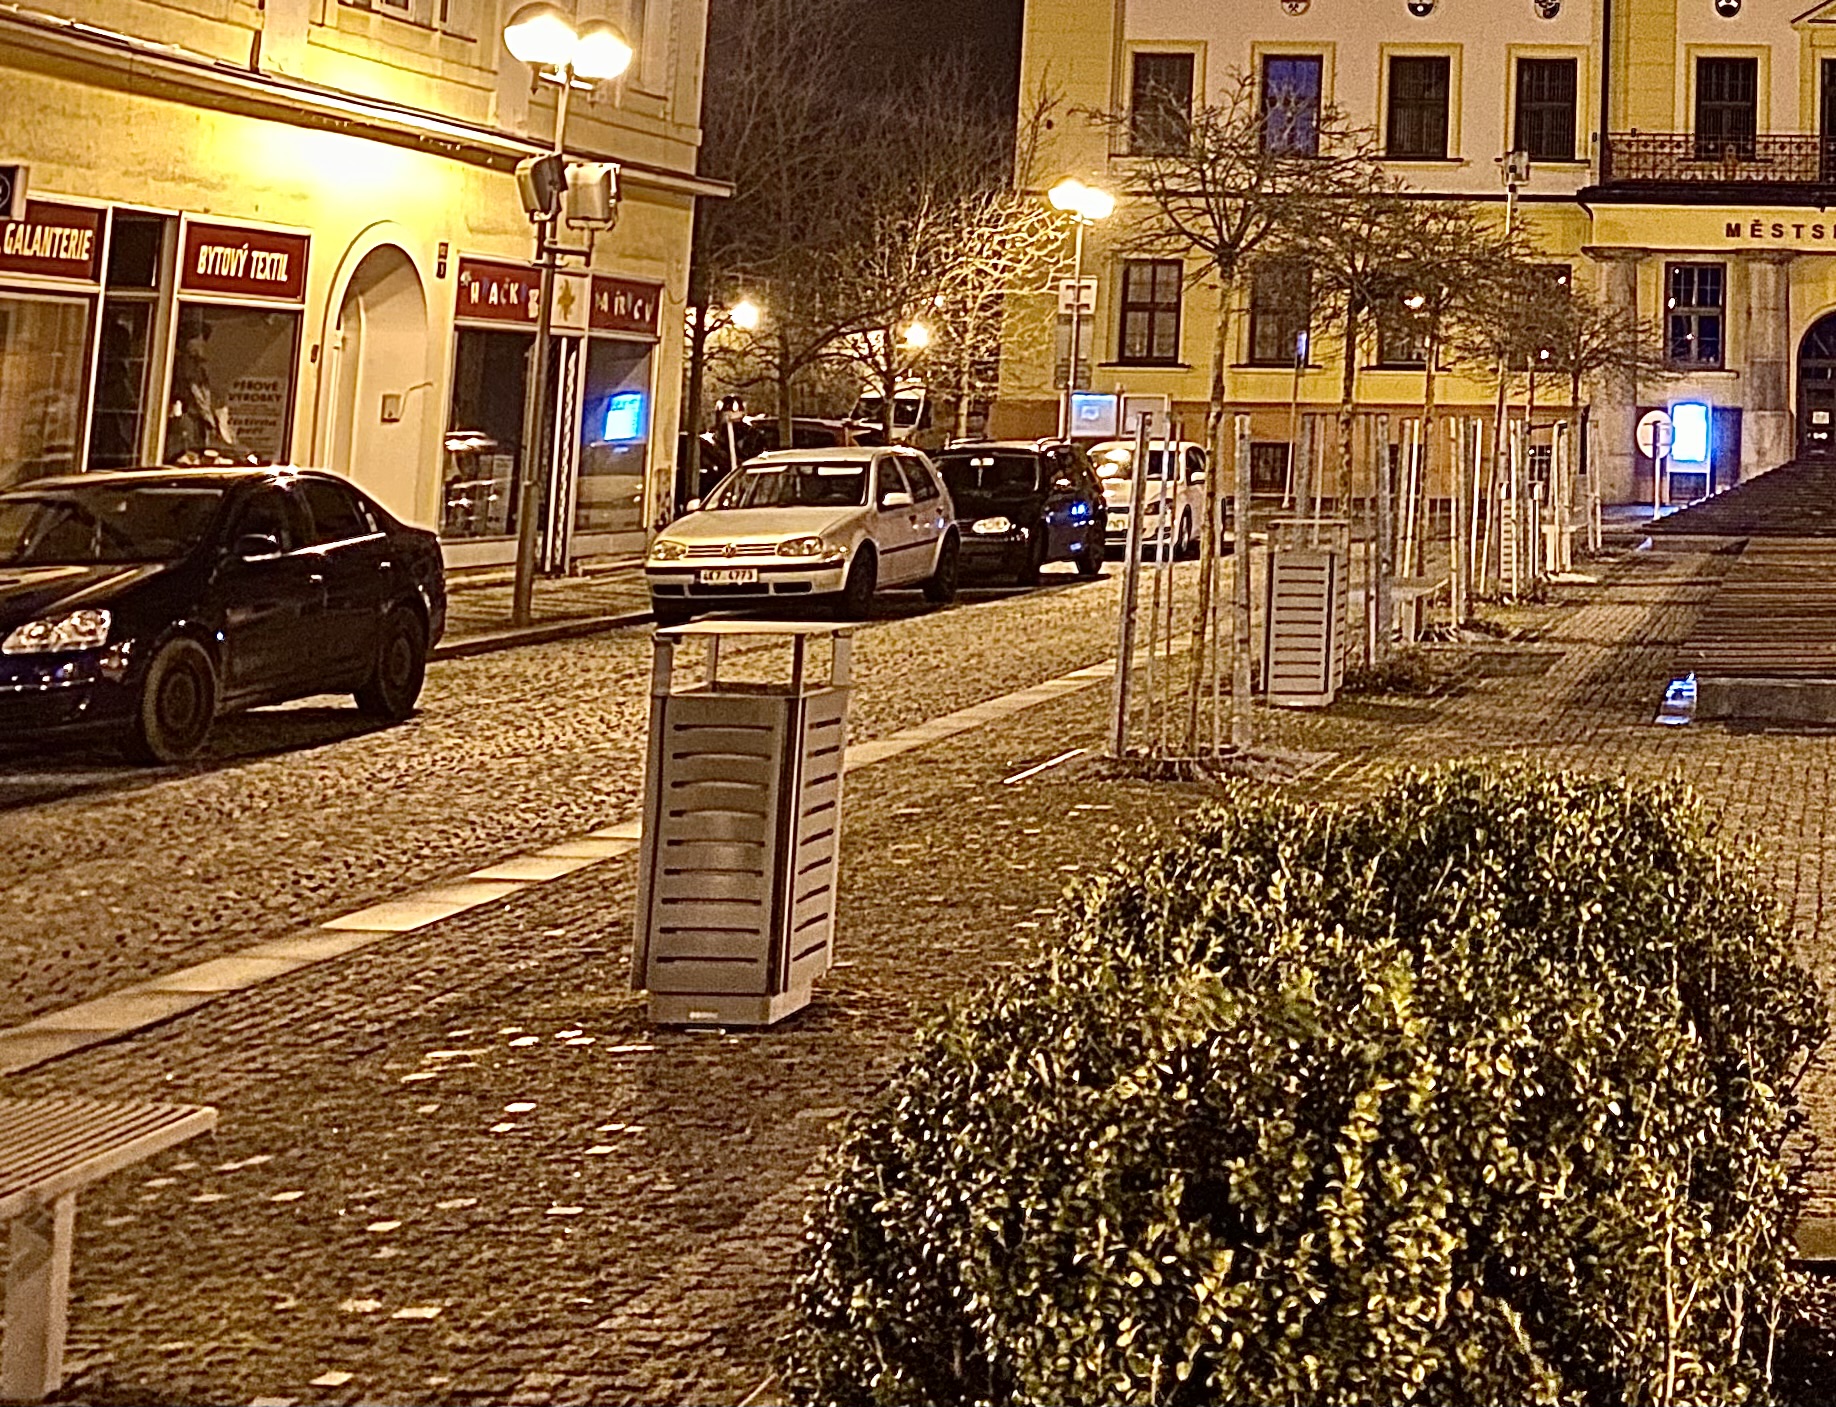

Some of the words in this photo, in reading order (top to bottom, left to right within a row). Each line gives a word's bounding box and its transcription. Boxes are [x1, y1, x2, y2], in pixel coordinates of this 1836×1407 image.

[3, 222, 93, 261] GALANTERIE
[196, 242, 249, 278] BYTOVÝ
[250, 250, 289, 282] TEXTIL
